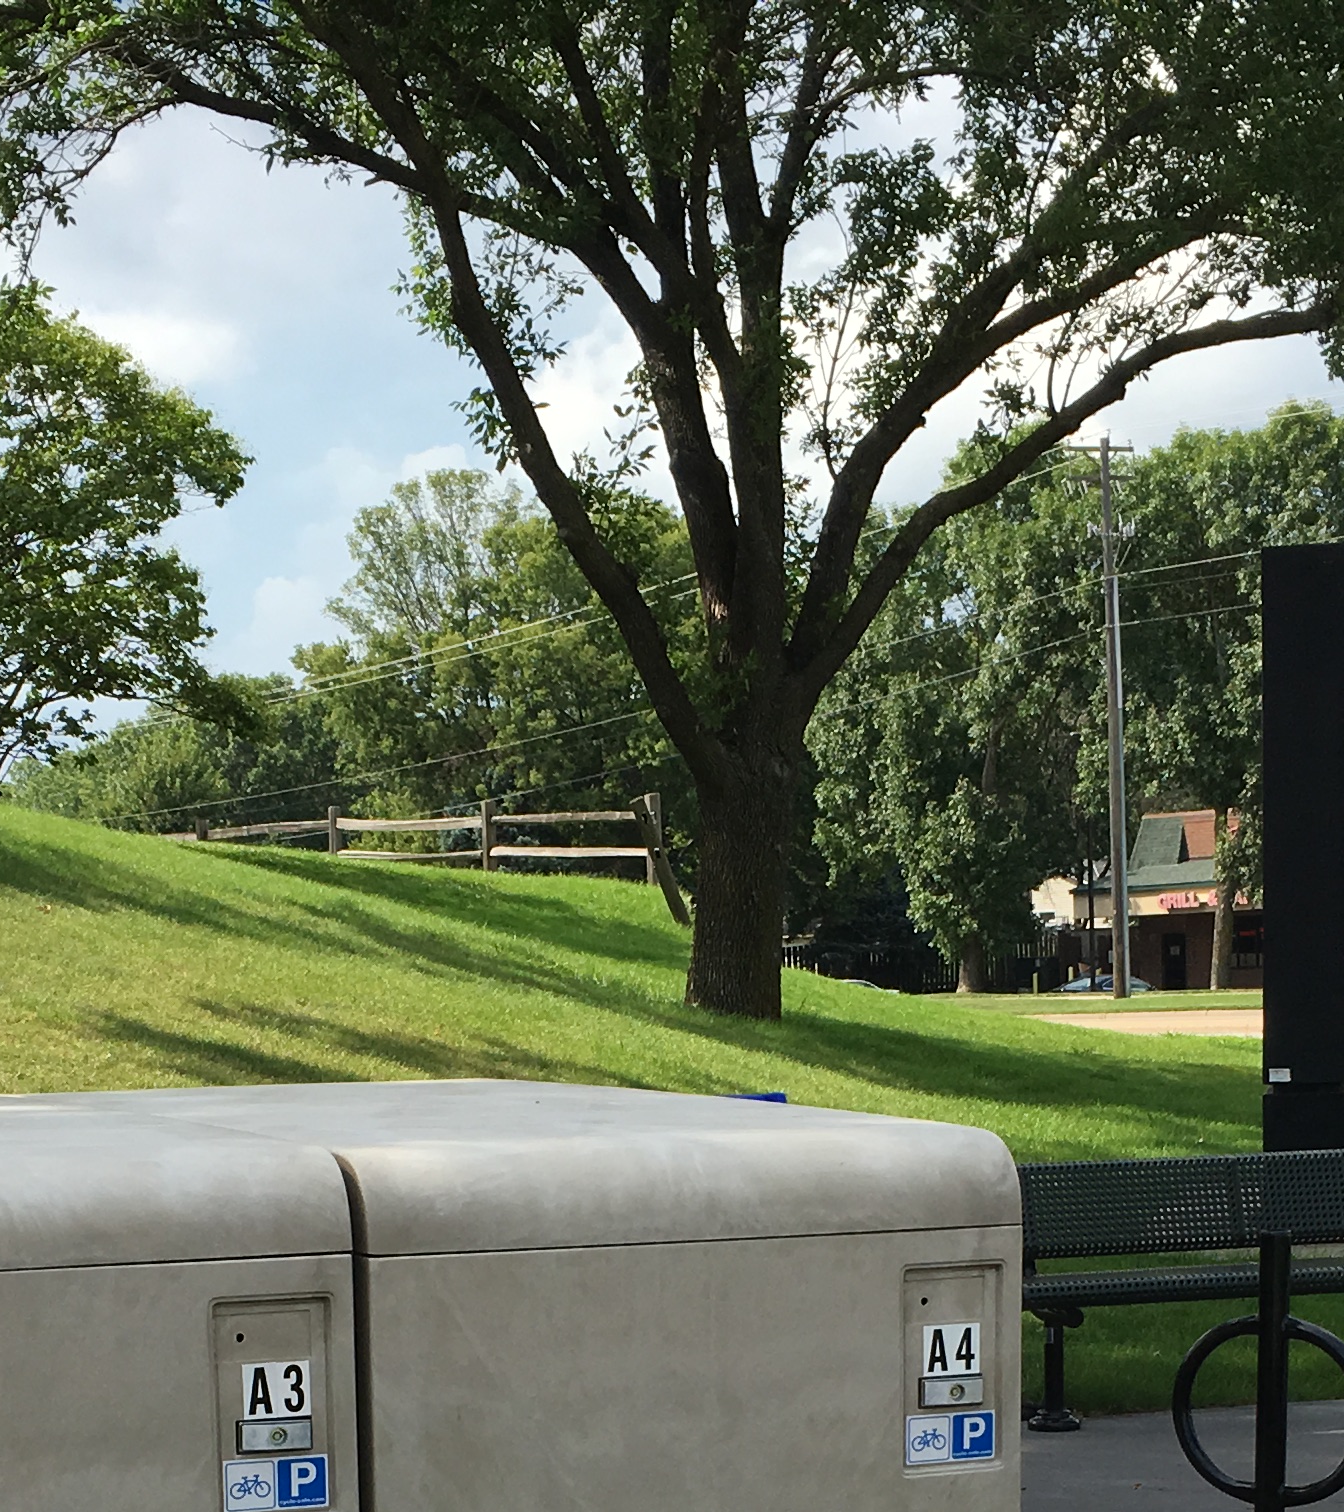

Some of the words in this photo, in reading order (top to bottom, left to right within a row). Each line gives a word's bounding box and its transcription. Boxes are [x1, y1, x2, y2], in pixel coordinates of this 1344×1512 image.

[1156, 891, 1200, 910] GRILL
[962, 1416, 987, 1450] P
[290, 1461, 317, 1497] P
